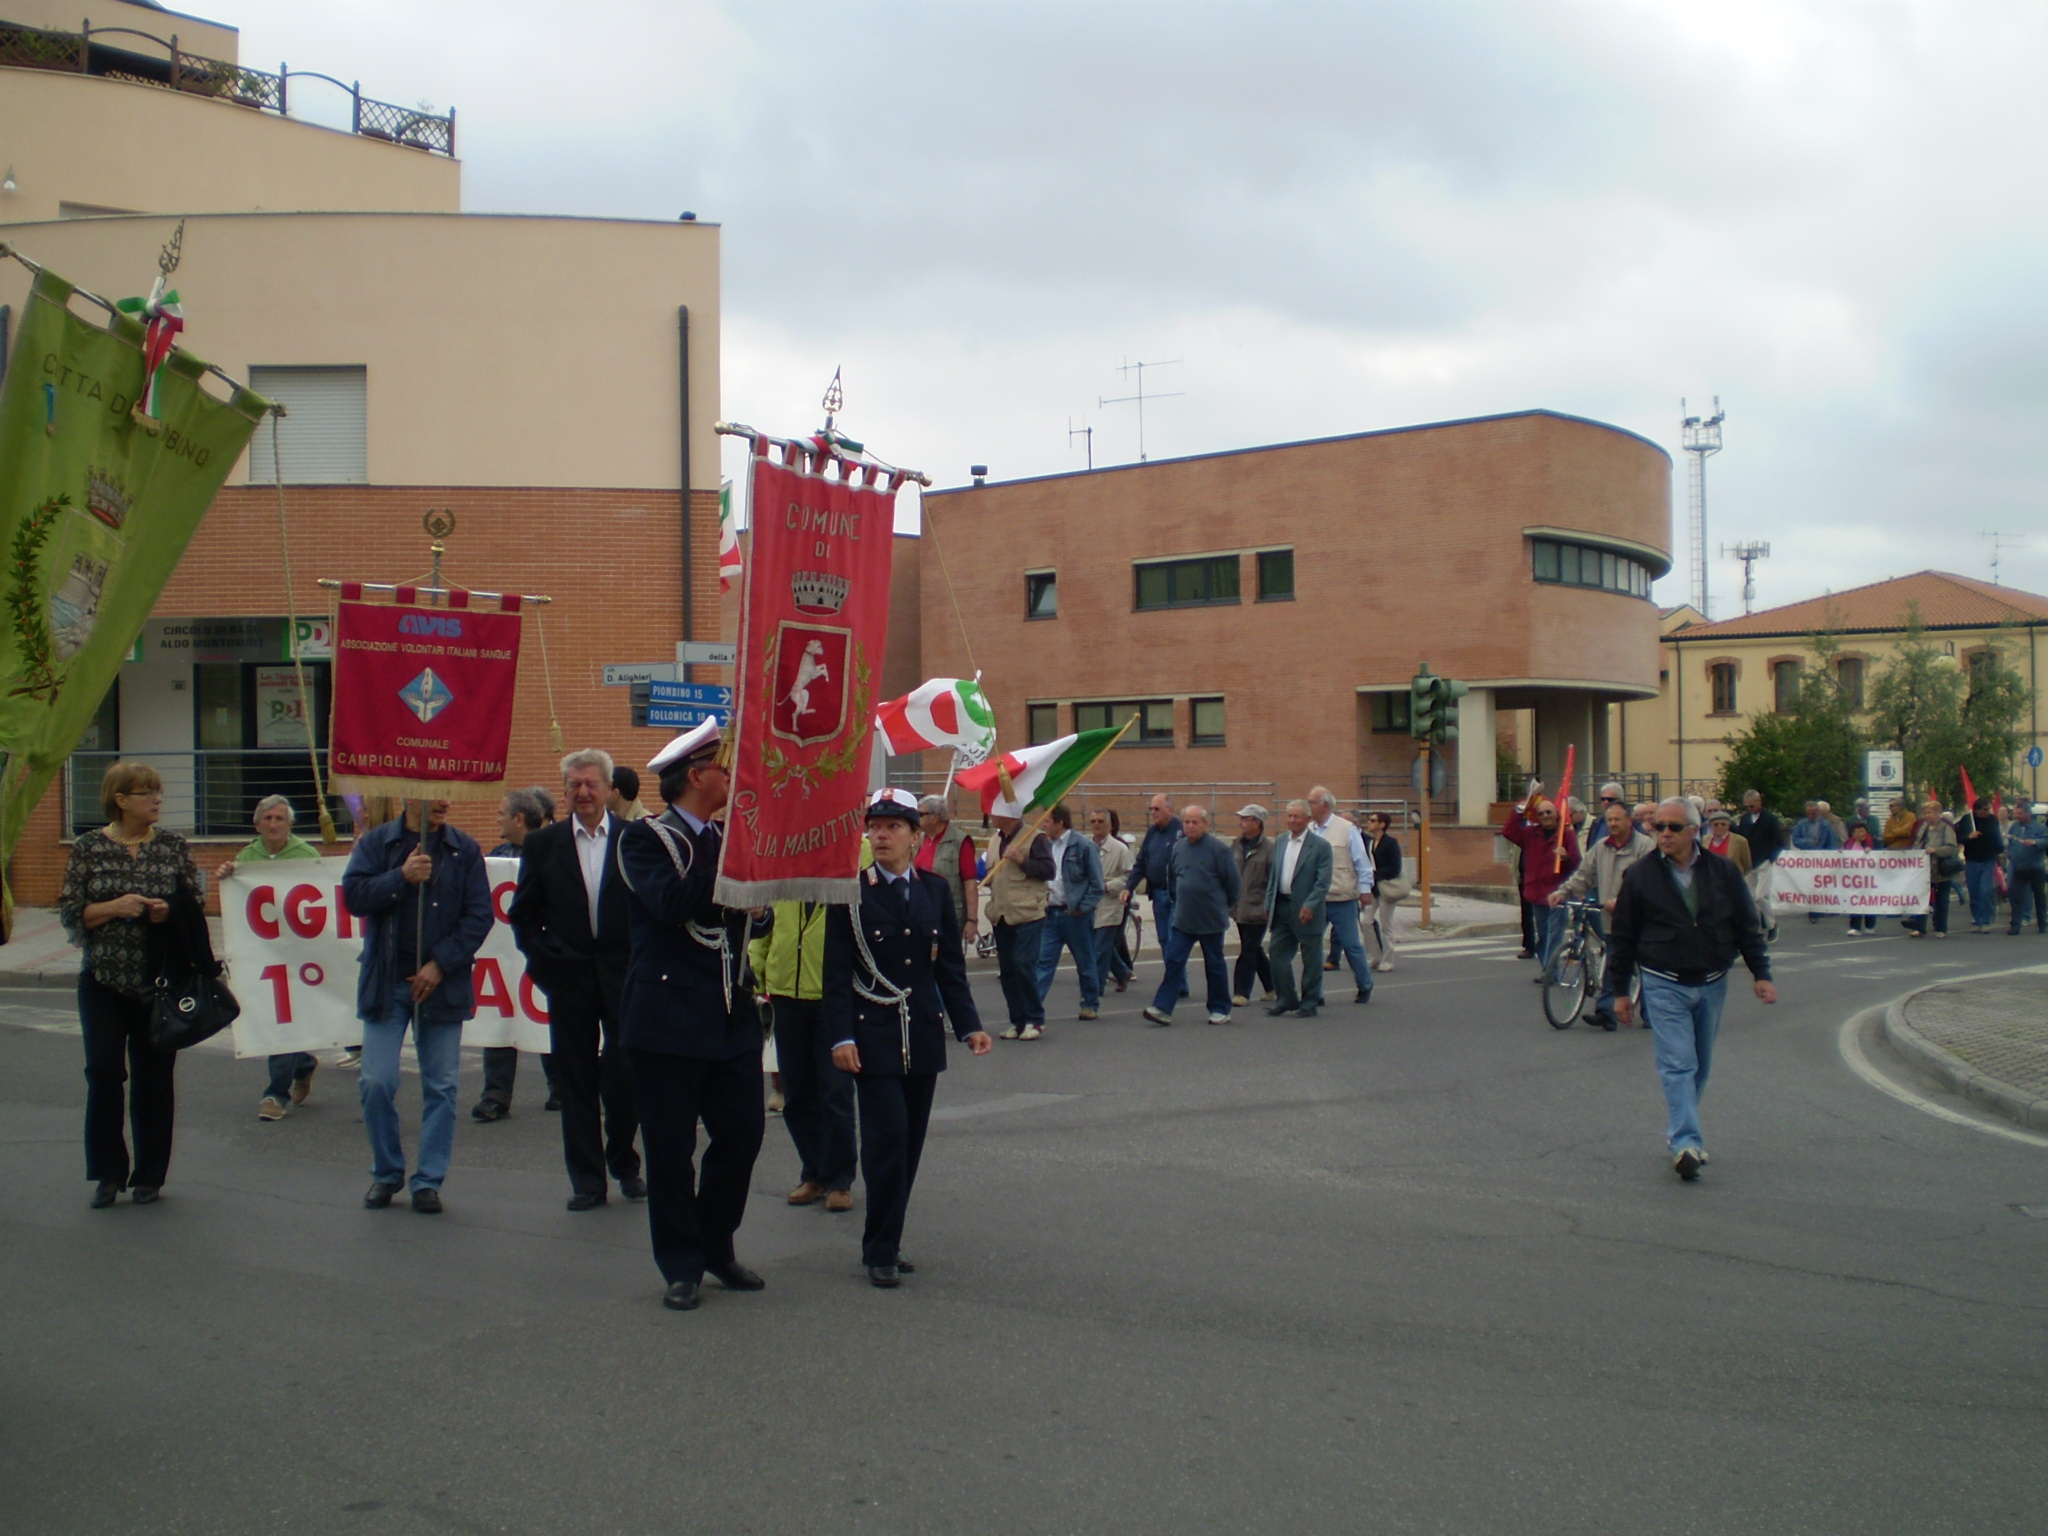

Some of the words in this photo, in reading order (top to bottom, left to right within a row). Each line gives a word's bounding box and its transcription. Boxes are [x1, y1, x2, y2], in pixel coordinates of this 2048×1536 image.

[786, 502, 861, 540] COMUNE
[815, 541, 830, 559] DI
[163, 625, 211, 636] CIRCOLO
[398, 614, 462, 638] AVIS
[296, 622, 332, 647] PD
[160, 639, 189, 649] ALDO
[340, 638, 398, 652] ASSOCIAZIONE
[401, 643, 444, 656] VOLONTARI
[447, 647, 477, 659] ITALIANI
[480, 649, 512, 660] SANGUE
[709, 653, 728, 661] della
[618, 673, 652, 683] Alighieri
[652, 686, 691, 698] PIOMBINO
[694, 689, 703, 699] 15
[650, 710, 693, 722] FOLLONICA
[697, 712, 706, 721] 18
[396, 736, 449, 749] COMUNALE
[337, 752, 417, 769] CAMPIGLIA
[428, 758, 503, 773] MARITTIMA
[1879, 857, 1925, 869] DONNE
[1814, 874, 1837, 888] SPI
[1842, 875, 1878, 889] CGIL
[1850, 895, 1920, 907] CAMPIGLIA
[246, 883, 365, 940] CGI
